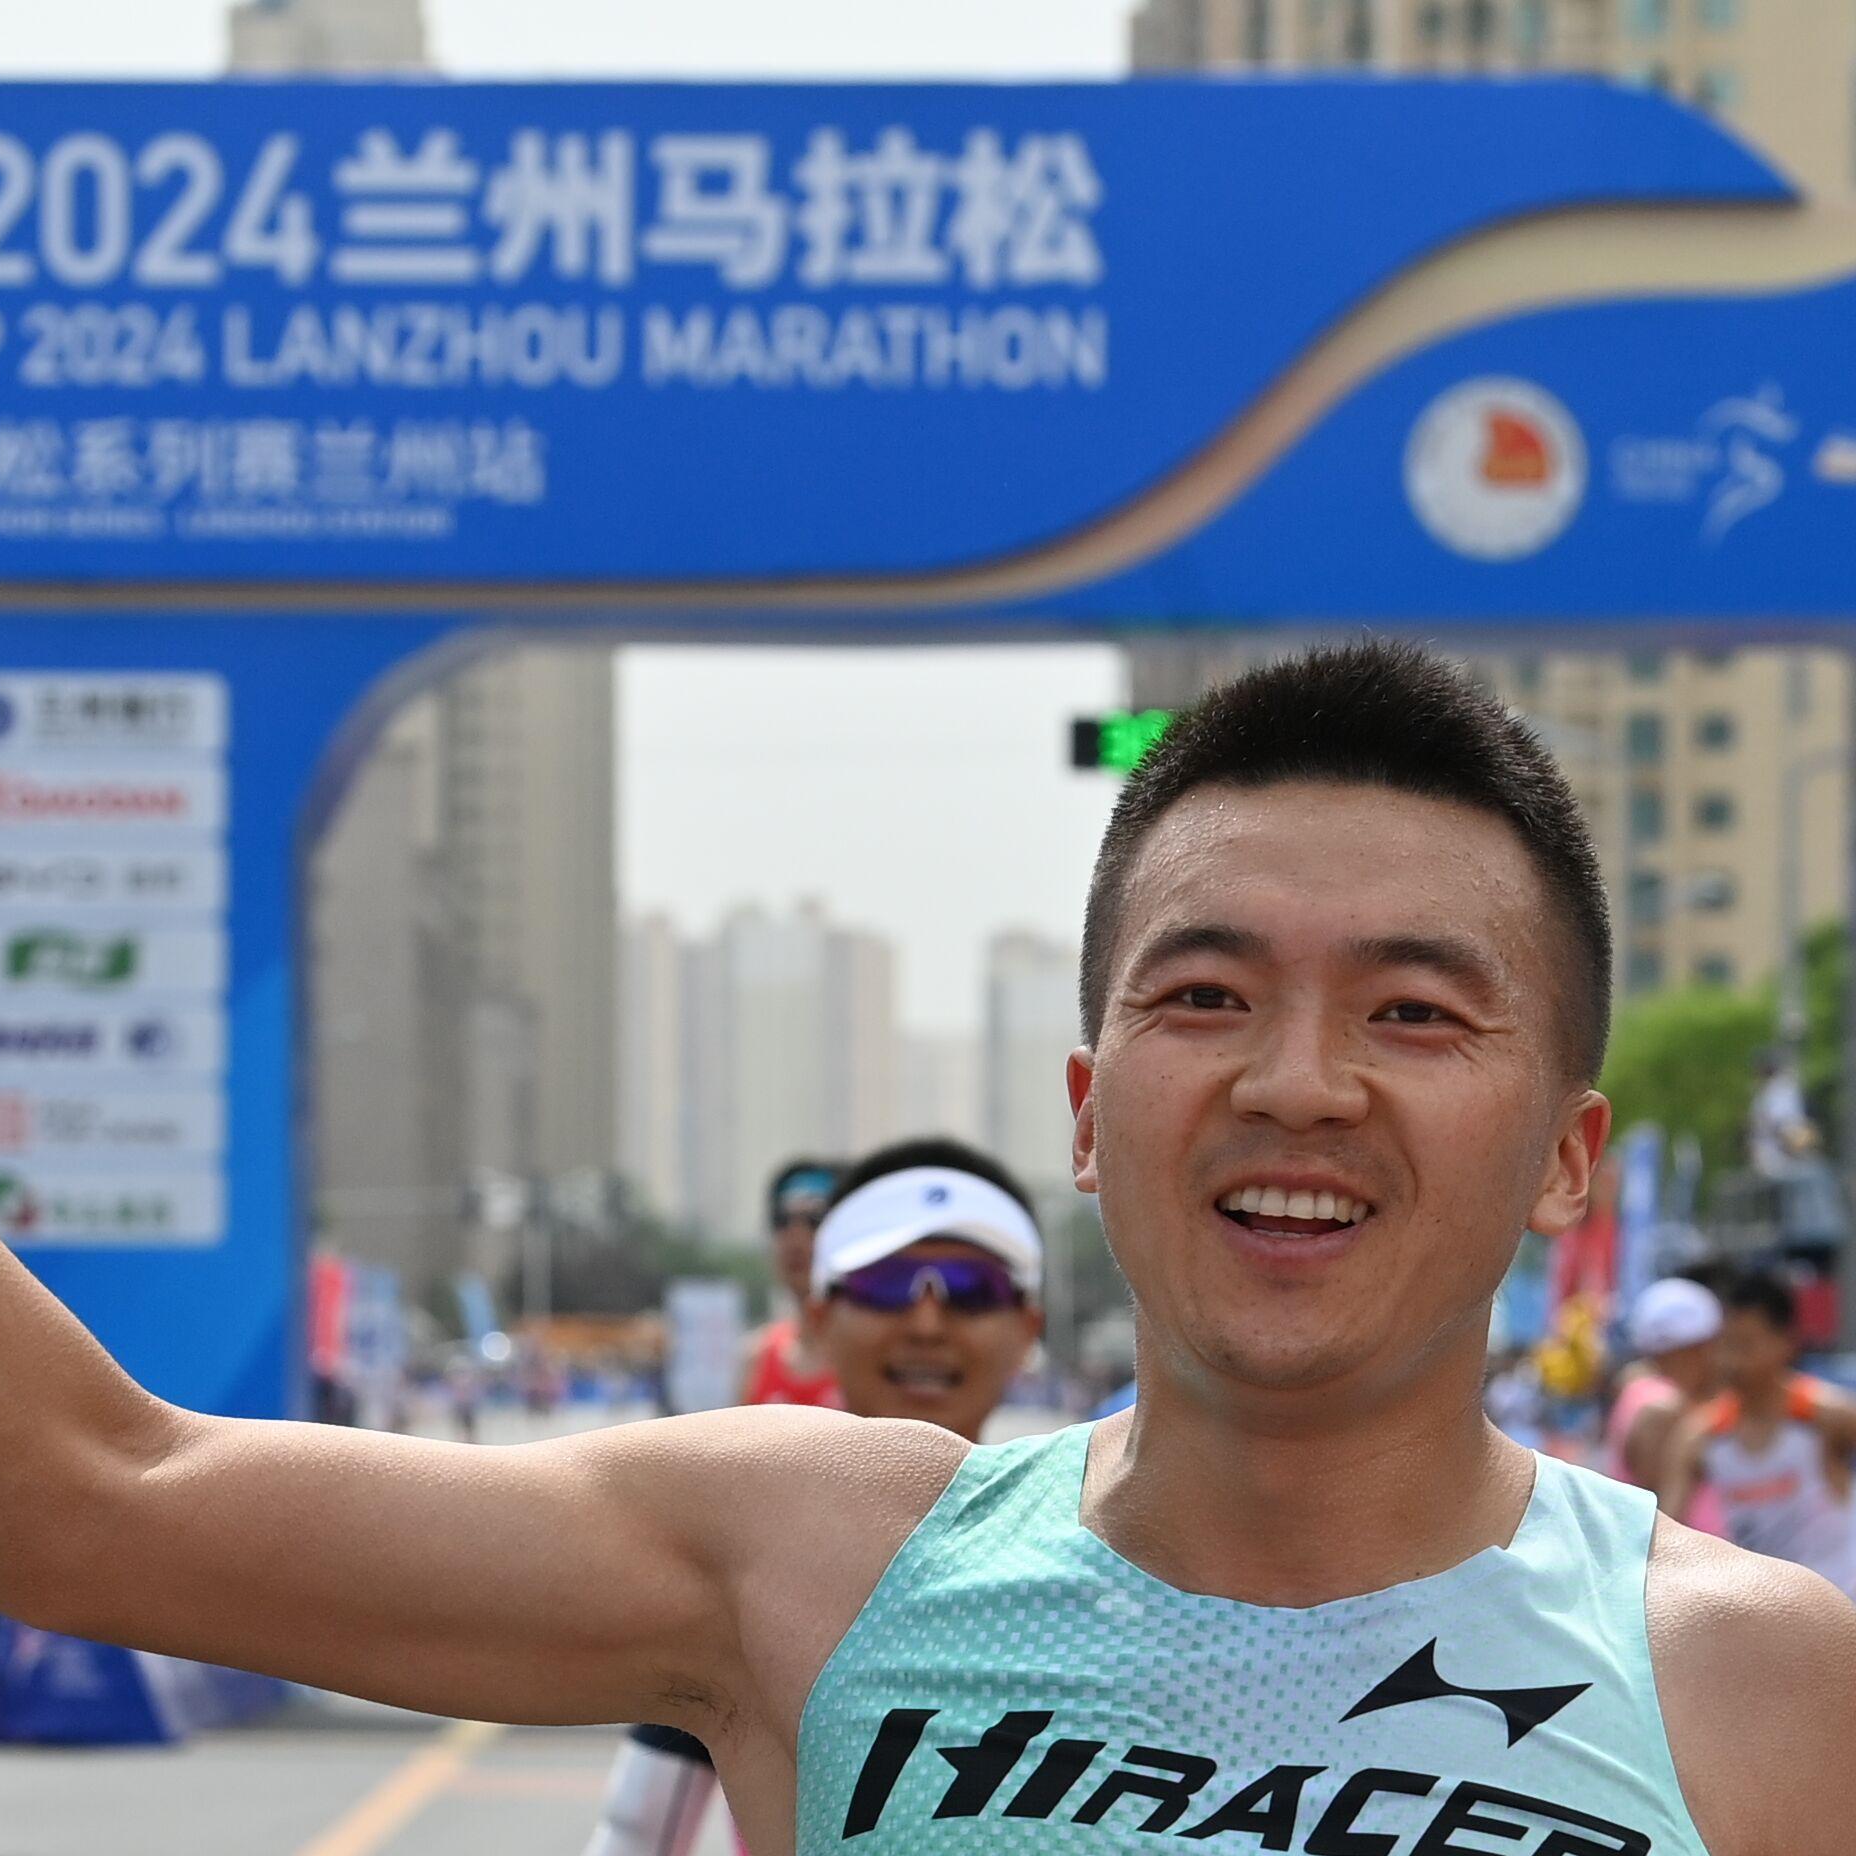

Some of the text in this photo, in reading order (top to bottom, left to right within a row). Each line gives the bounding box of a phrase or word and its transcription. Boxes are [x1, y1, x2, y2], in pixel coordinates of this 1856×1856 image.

[18, 302, 207, 388] 2024
[222, 302, 622, 388] LANZHOU
[641, 302, 1108, 389] MARATHON
